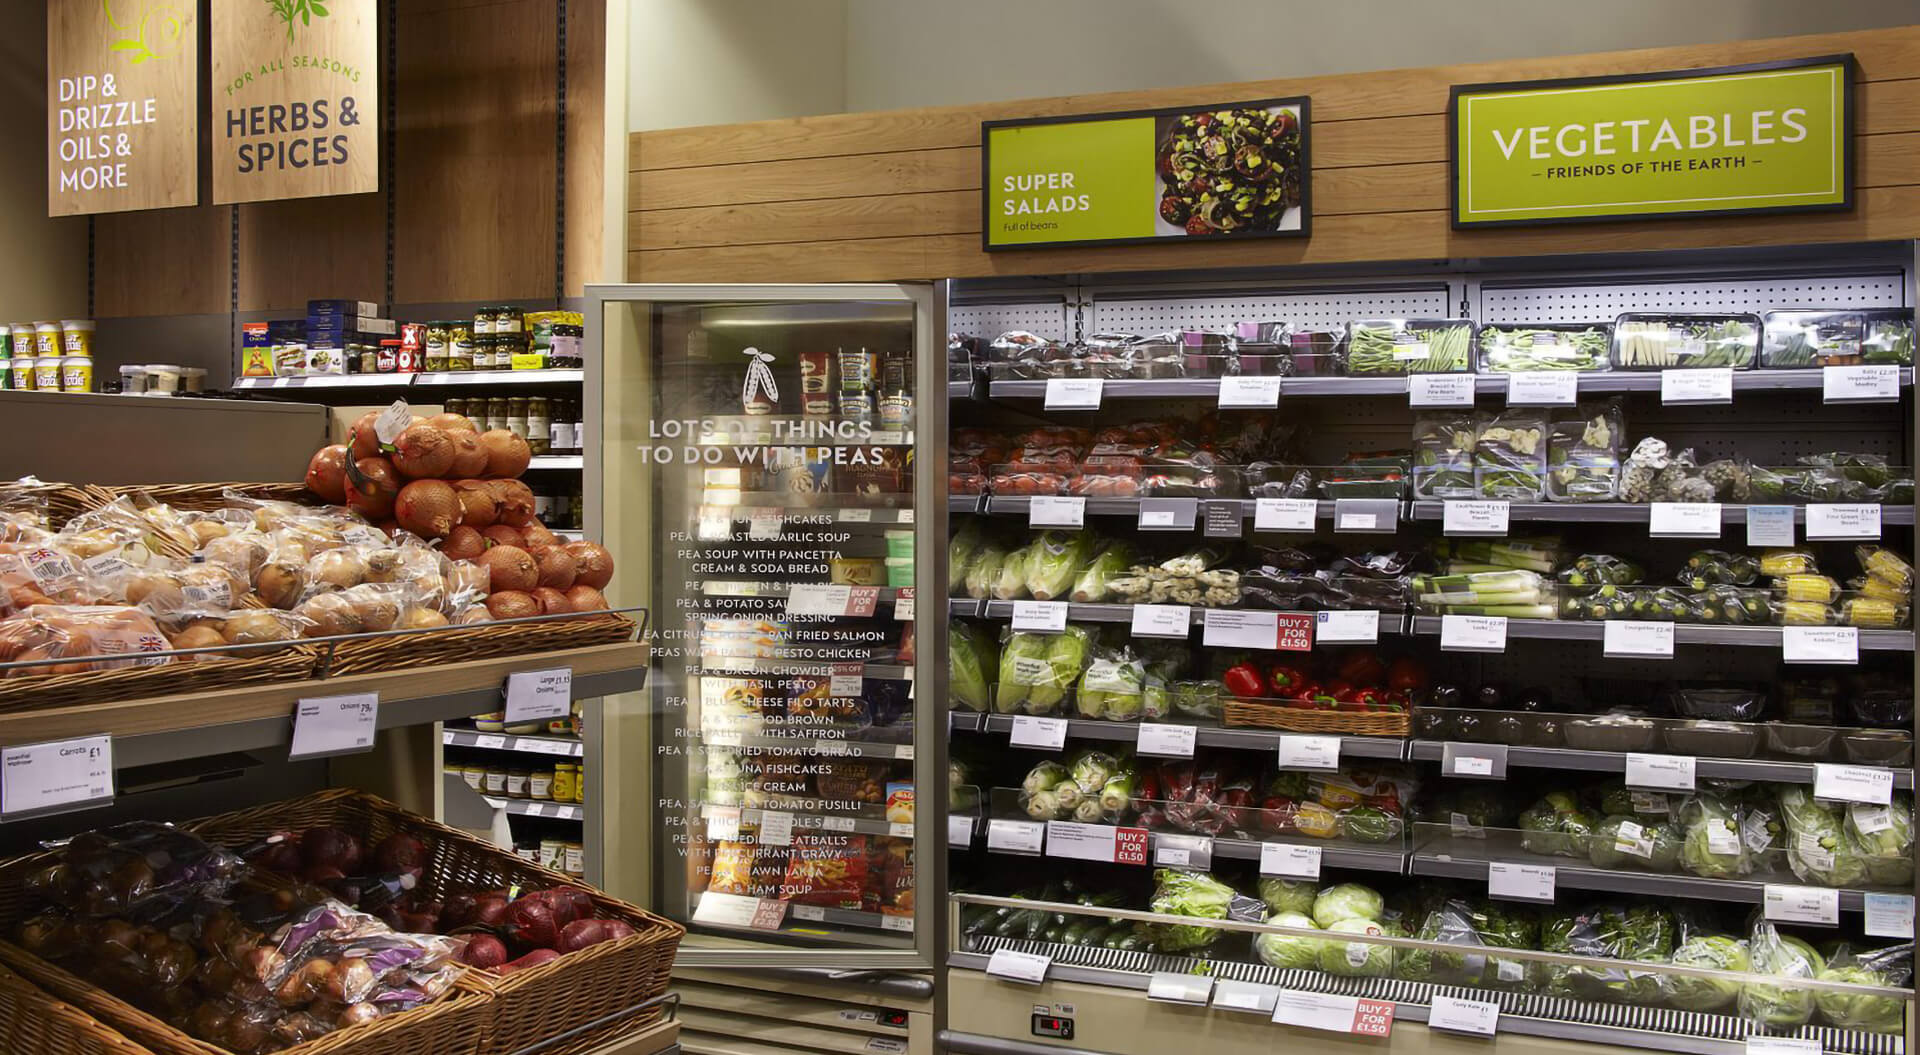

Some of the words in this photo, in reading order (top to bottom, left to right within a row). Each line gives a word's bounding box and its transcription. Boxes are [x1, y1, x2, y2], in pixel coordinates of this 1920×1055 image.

[226, 71, 254, 96] FOR
[259, 58, 284, 76] ALL
[292, 55, 361, 83] SEASONS
[59, 77, 97, 102] DIP
[101, 73, 118, 97] &
[59, 98, 157, 132] DRIZZLE
[226, 99, 329, 138] HERBS
[339, 96, 360, 126] &
[1491, 107, 1808, 161] VEGETABLES
[59, 135, 111, 162] OILS
[115, 133, 132, 157] &
[237, 135, 349, 173] SPICES
[1546, 163, 1616, 180] FRIENDS
[1621, 161, 1645, 176] OF
[1649, 158, 1683, 173] THE
[1688, 155, 1746, 171] EARTH
[59, 163, 129, 193] MORE
[1003, 172, 1075, 192] SUPER
[1003, 194, 1090, 216] SALADS
[1003, 222, 1018, 232] Full
[1019, 221, 1030, 231] of
[1030, 220, 1058, 231] beans
[649, 419, 715, 438] LOTS
[725, 419, 760, 438] OF
[770, 419, 873, 439] THINGS
[636, 446, 674, 464] TO
[683, 446, 724, 464] DO
[733, 446, 807, 465] WITH
[817, 446, 884, 465] PEAS
[773, 514, 833, 525] FISHCAKES
[670, 532, 694, 542] PEA
[711, 532, 770, 542] OASTED
[772, 532, 814, 542] GARLIC
[817, 532, 851, 542] SOUP
[678, 550, 701, 560] PEA
[705, 550, 739, 560] SOUP
[742, 550, 776, 560] WITH
[779, 550, 844, 561] PANCETTA
[691, 563, 735, 574] CREAM
[738, 563, 747, 574] &
[750, 563, 785, 574] SODA
[788, 564, 830, 574] BREAD
[685, 581, 705, 591] PEA
[772, 582, 783, 591] &
[851, 588, 869, 598] BUY
[869, 589, 877, 598] 2
[676, 599, 699, 609] PEA
[703, 599, 713, 609] &
[716, 599, 764, 609] POTATO
[854, 597, 871, 606] FOR
[685, 612, 730, 622] SPRING
[732, 612, 775, 623] ONION
[777, 612, 836, 624] DRESSING
[1279, 618, 1301, 627] BUY
[768, 630, 793, 641] PAN
[796, 631, 830, 641] FRIED
[832, 631, 885, 642] SALMON
[1284, 629, 1306, 638] FOR
[1280, 638, 1308, 648] £1.50
[650, 647, 681, 658] PEAS
[775, 648, 814, 659] PESTO
[817, 649, 871, 659] CHICKEN
[685, 665, 707, 675] PEA
[725, 666, 768, 676] BACON
[772, 665, 836, 676] CHOWDER
[777, 680, 817, 690] PESTO
[340, 702, 360, 711] Onions
[665, 697, 689, 707] PEA
[786, 697, 813, 708] FILO
[817, 697, 856, 708] TARTS
[786, 716, 834, 725] BROWN
[674, 728, 703, 738] RICE
[706, 729, 749, 739] PAELL
[789, 729, 846, 740] SAFFRON
[59, 747, 87, 757] Carrots
[89, 747, 100, 758] £1
[658, 746, 682, 756] PEA
[766, 746, 819, 757] TOMATO
[765, 764, 833, 776] FISHCAKES
[762, 782, 807, 793] CREAM
[763, 799, 816, 810] TOMATO
[818, 800, 861, 811] FUSILLI
[665, 817, 689, 827] PEA
[691, 817, 701, 827] &
[673, 835, 704, 845] PEAS
[789, 836, 848, 847] EATBALLS
[1117, 832, 1137, 842] BUY
[1138, 834, 1147, 843] 2
[1121, 842, 1142, 852] FOR
[678, 848, 711, 858] WITH
[800, 849, 843, 860] GRAVY
[1118, 851, 1144, 862] £1.50
[746, 885, 776, 895] HAM
[778, 885, 813, 895] SOUP
[759, 902, 776, 911] BUY
[761, 911, 779, 919] FOR
[1358, 1003, 1383, 1014] BUY
[1385, 1006, 1392, 1016] 2
[1362, 1014, 1385, 1024] FOR
[1357, 1024, 1387, 1034] £1.50
